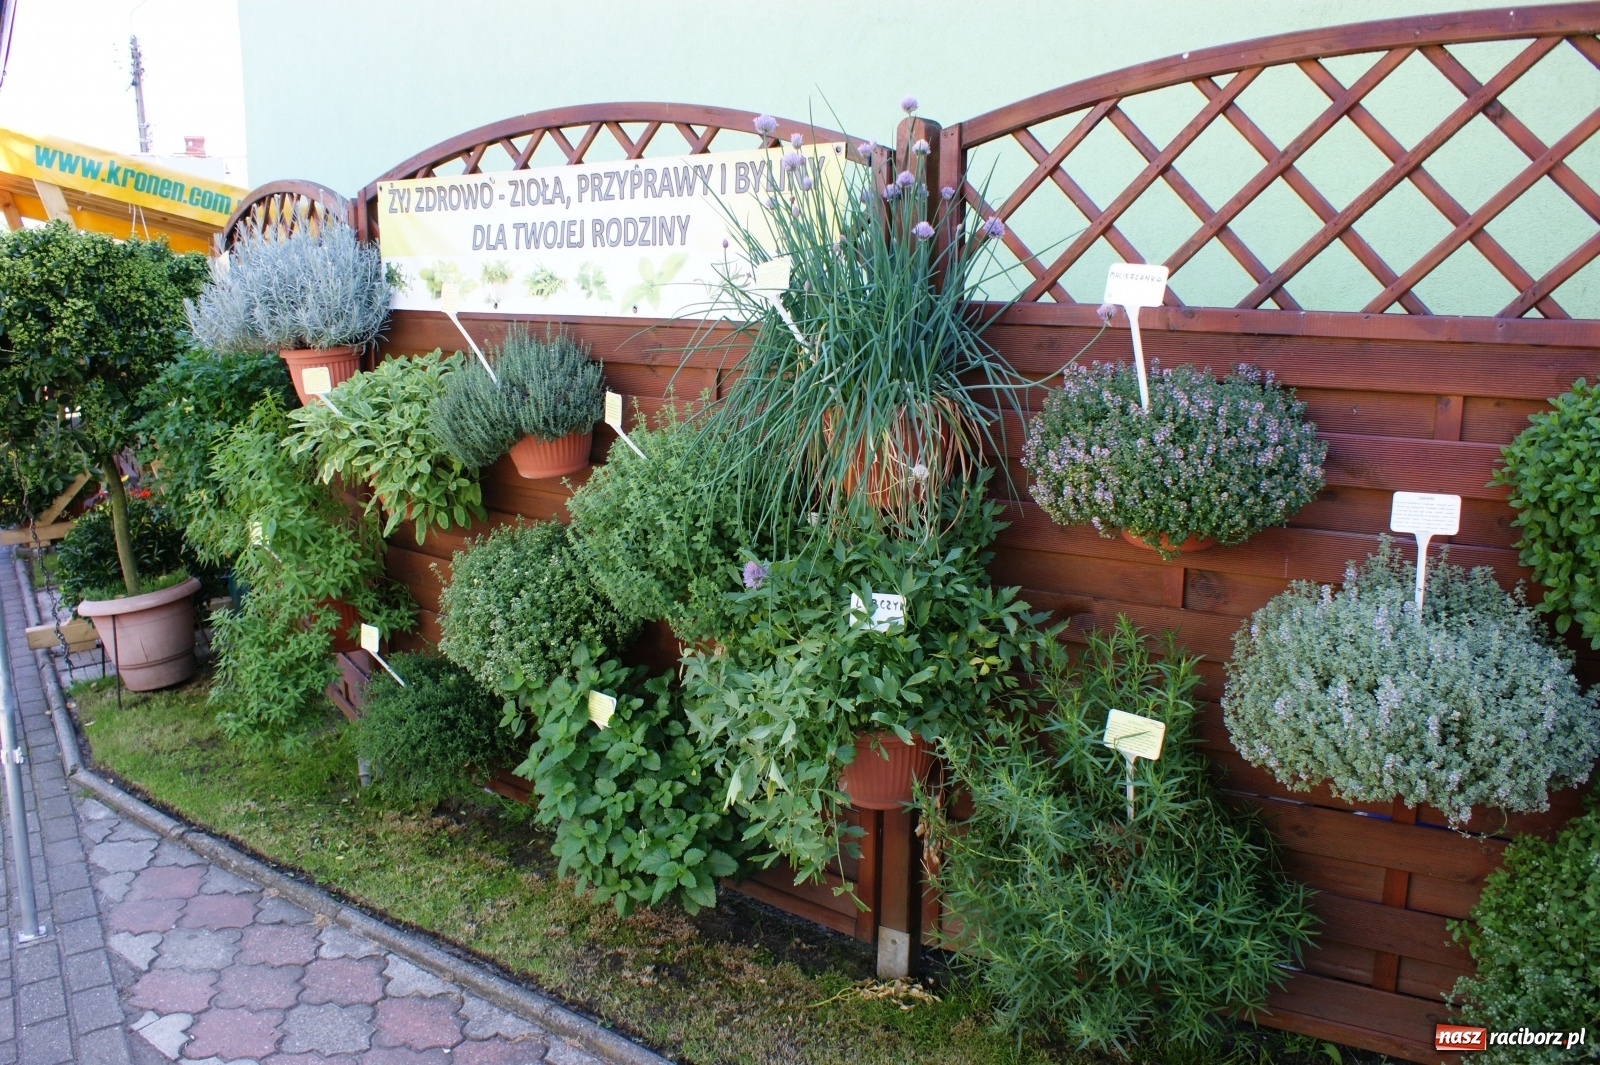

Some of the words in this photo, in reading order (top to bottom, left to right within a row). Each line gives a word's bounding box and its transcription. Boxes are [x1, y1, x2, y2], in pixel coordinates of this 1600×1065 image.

[388, 182, 411, 213] ŻYJ
[414, 181, 494, 213] ZDROWO
[508, 175, 571, 210] ZIOŁA,
[577, 163, 713, 203] PRZYPRAWY
[720, 163, 727, 194] I
[472, 223, 508, 251] DLA
[512, 219, 585, 250] TWOJEJ
[592, 215, 691, 248] RODZINY
